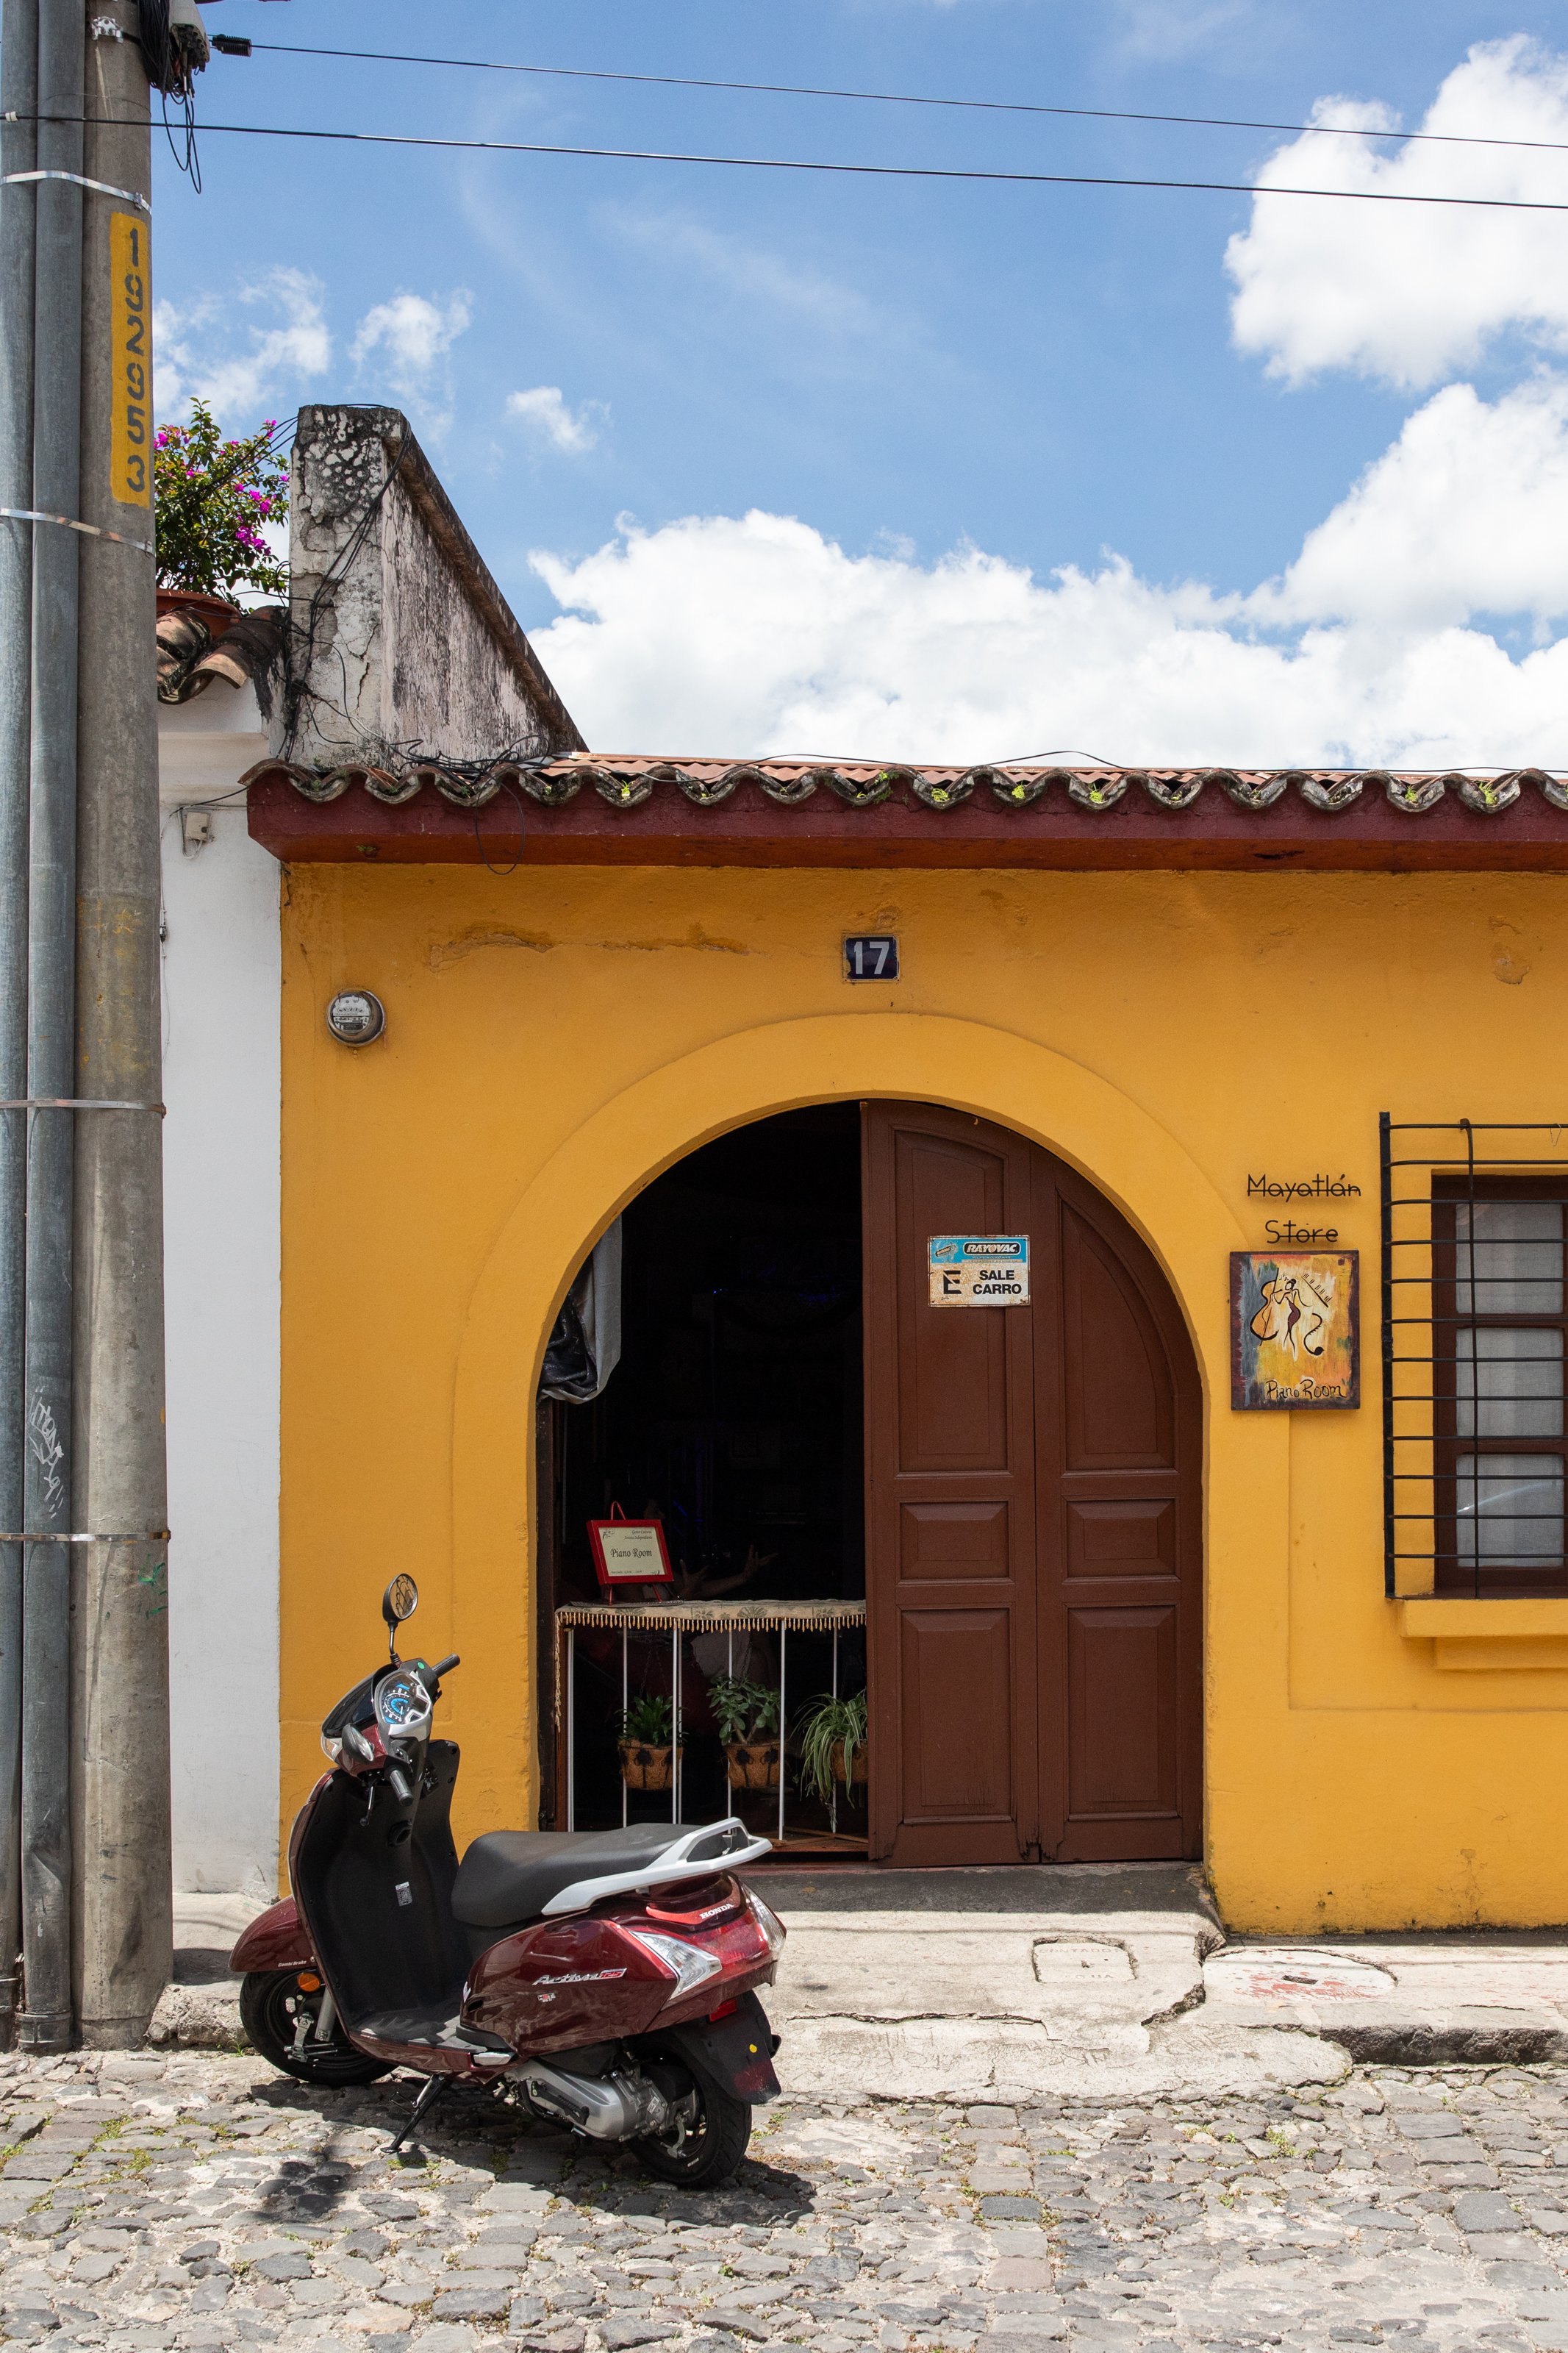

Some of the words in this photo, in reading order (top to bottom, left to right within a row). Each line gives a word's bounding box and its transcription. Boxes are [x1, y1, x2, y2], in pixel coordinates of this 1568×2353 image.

[125, 228, 146, 493] 192953
[853, 941, 889, 974] 17
[1247, 1174, 1361, 1203] Mayatlán
[1265, 1220, 1338, 1244] Store
[967, 1244, 1017, 1253] RAYOVAC
[943, 1270, 962, 1294] E
[979, 1270, 1015, 1280] SALE
[973, 1284, 1022, 1294] CARRO
[1266, 1379, 1300, 1399] Piano
[1300, 1379, 1347, 1399] Room
[611, 1548, 631, 1557] Piano
[632, 1548, 652, 1558] Room
[699, 1903, 734, 1919] HONDA
